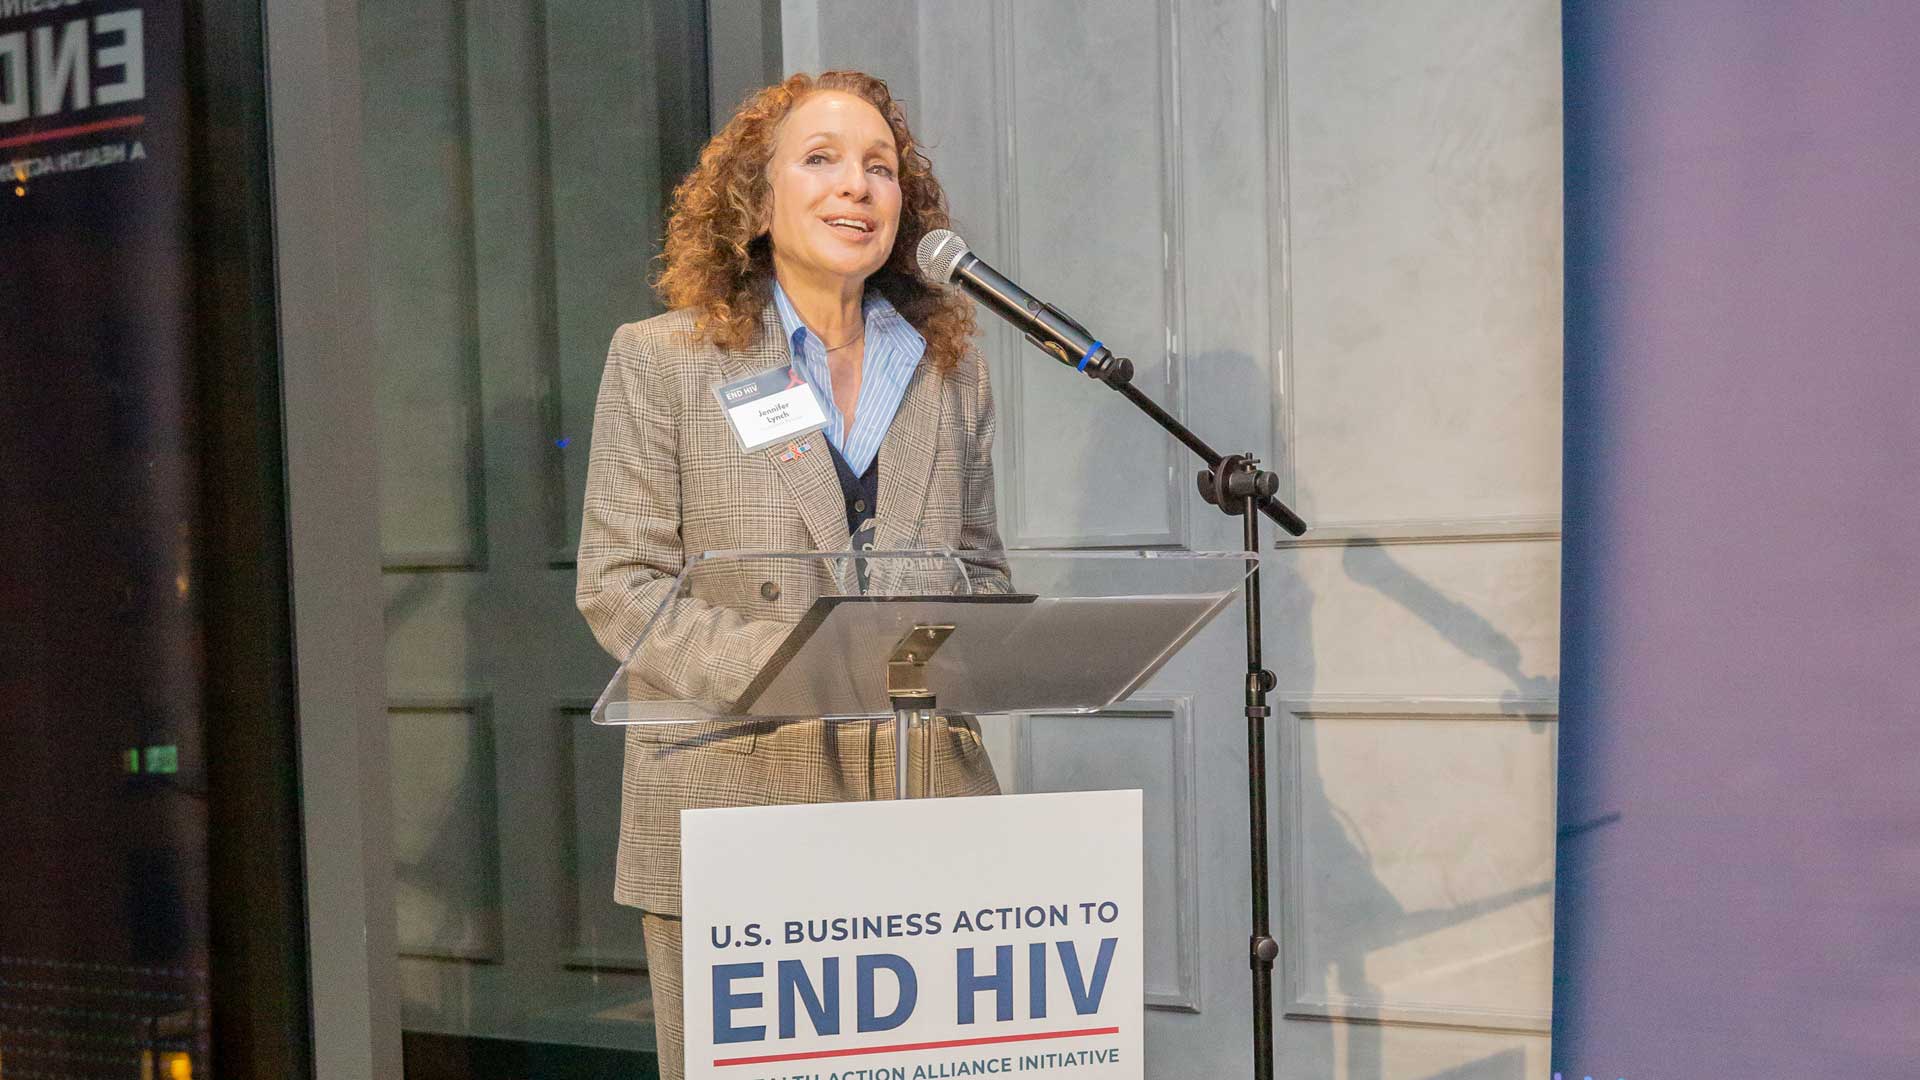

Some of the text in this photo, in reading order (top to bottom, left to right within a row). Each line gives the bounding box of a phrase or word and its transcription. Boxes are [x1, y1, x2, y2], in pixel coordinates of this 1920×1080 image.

[725, 390, 743, 401] END
[743, 384, 758, 395] HIV
[758, 402, 790, 418] Jennifer
[766, 411, 790, 424] Lynch
[711, 901, 1119, 949] U.S. BUSINESS ACTION TO
[712, 937, 1119, 1045] END HIV
[912, 1057, 1012, 1080] ALLIANCE
[1019, 1048, 1120, 1071] INITIATIVE
